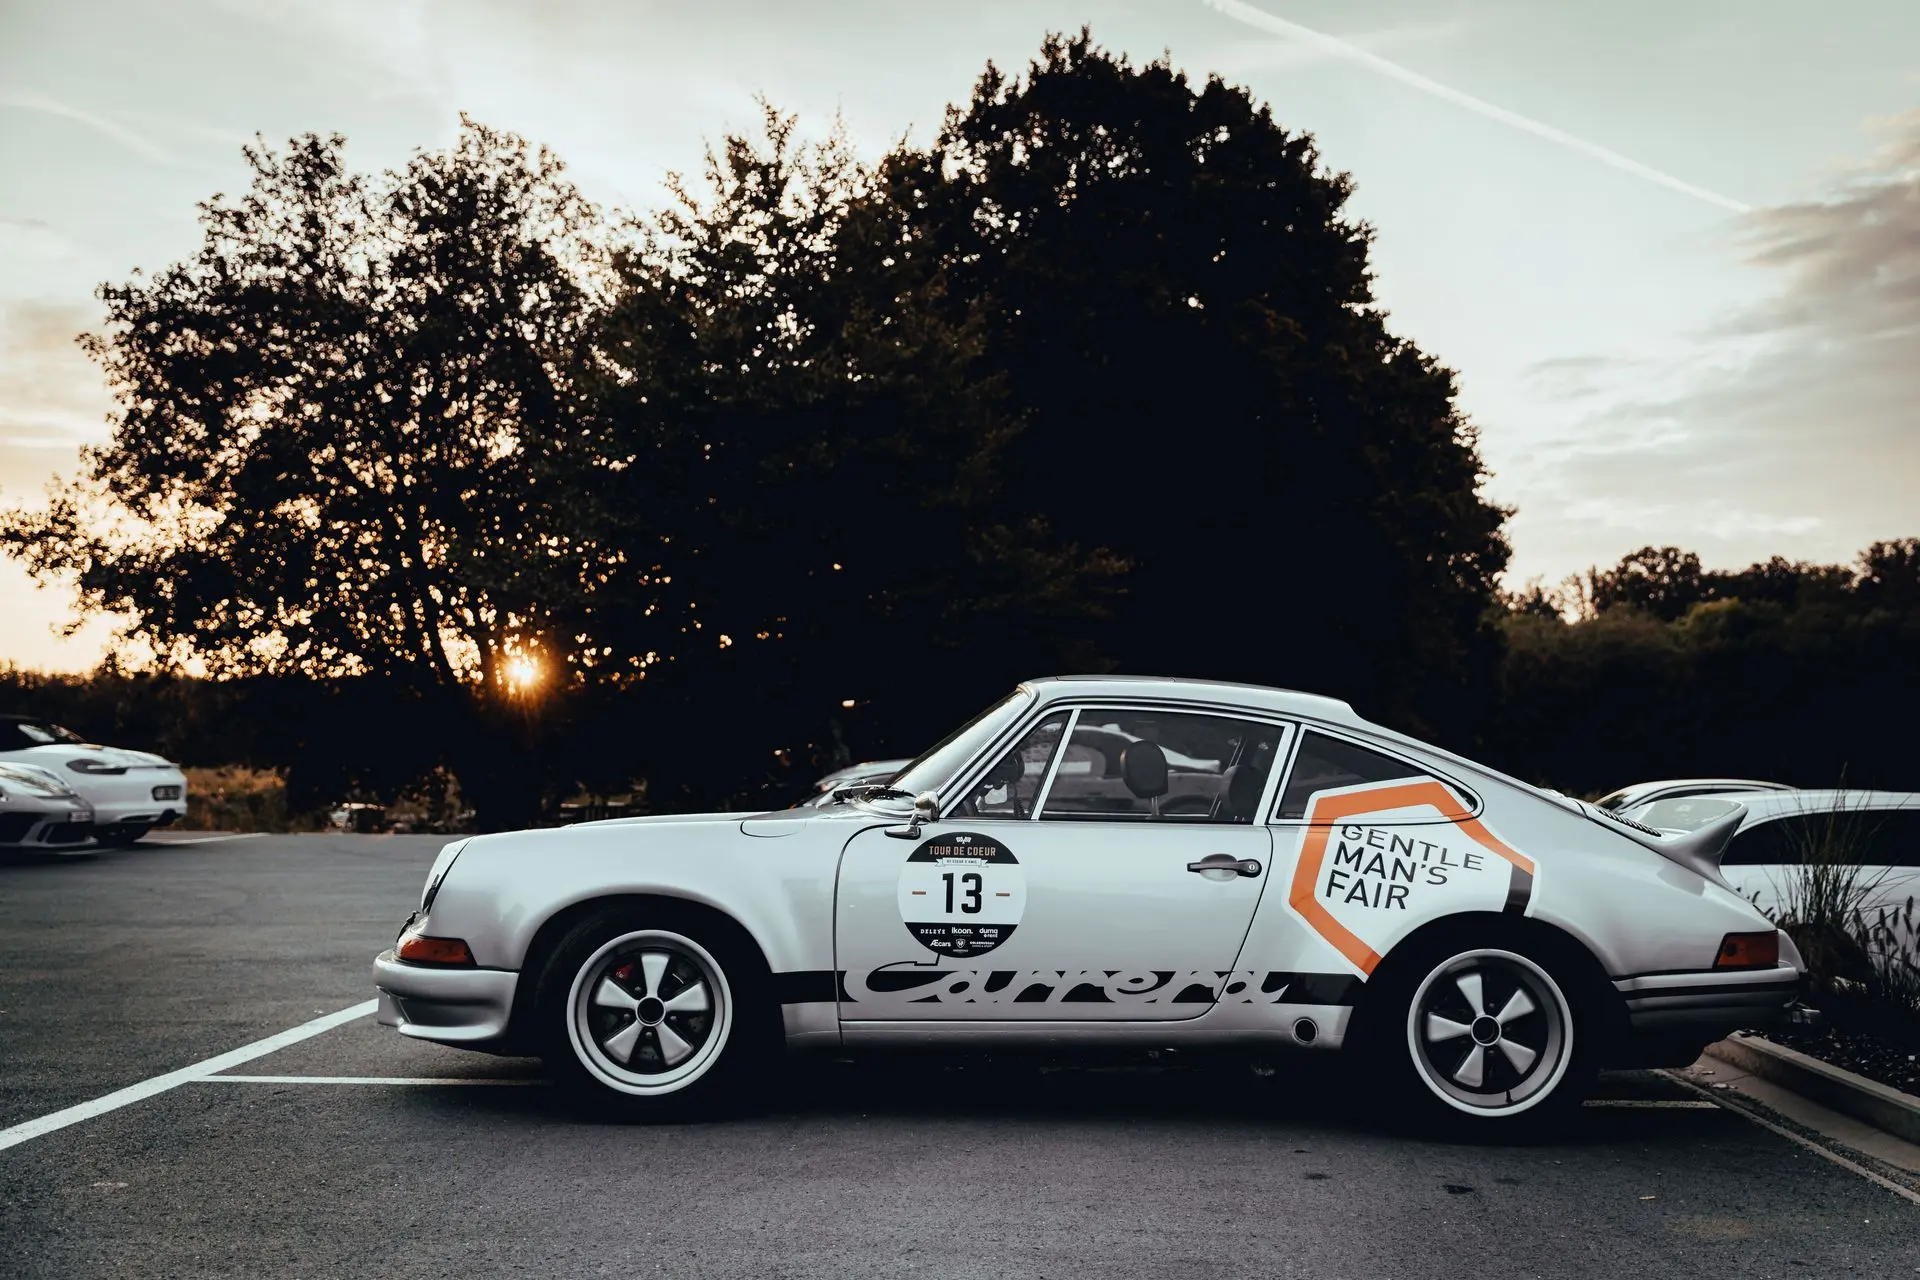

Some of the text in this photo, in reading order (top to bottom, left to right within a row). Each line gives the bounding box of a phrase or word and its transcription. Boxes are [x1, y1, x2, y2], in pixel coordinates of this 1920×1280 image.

[929, 846, 996, 856] TOUR DE COEUR
[1333, 841, 1448, 885] MAN'S
[1341, 825, 1484, 871] GENTLE
[942, 872, 983, 914] 13
[1325, 869, 1410, 910] FAIR
[843, 960, 1290, 1003] Carrera
